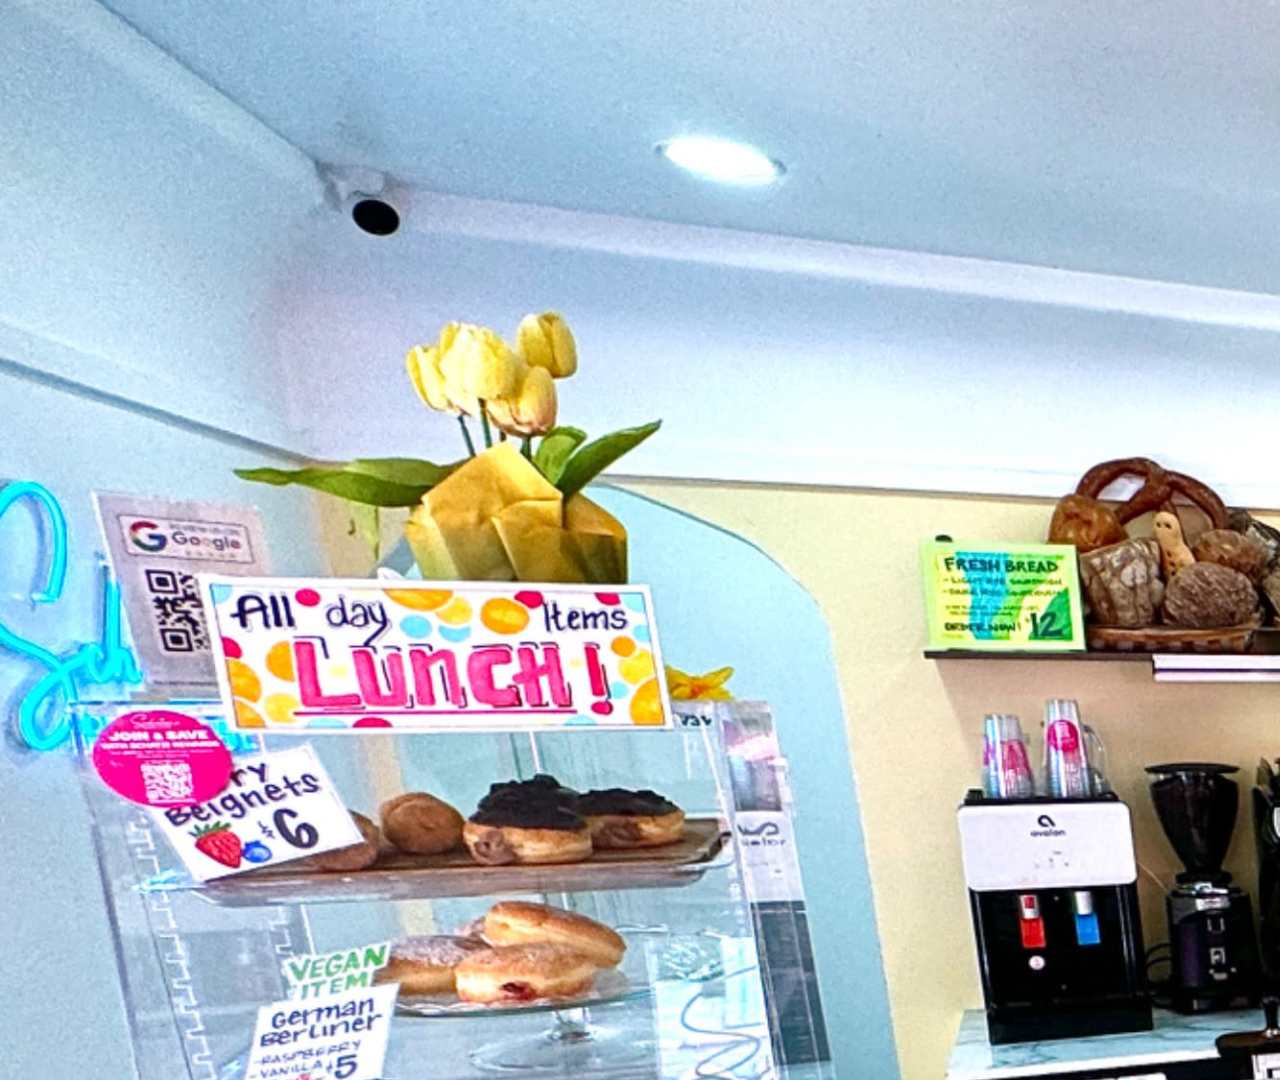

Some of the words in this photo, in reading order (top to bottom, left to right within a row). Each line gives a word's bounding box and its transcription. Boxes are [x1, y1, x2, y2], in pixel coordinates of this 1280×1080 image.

[172, 532, 241, 551] Google
[944, 558, 1000, 572] FRESH
[1005, 560, 1058, 573] BREAD
[230, 594, 295, 627] All
[326, 596, 389, 646] day
[543, 601, 628, 631] Items
[109, 731, 150, 742] JOIN
[166, 730, 208, 740] SAVE
[164, 772, 320, 826] Beignets
[288, 944, 387, 981] VEGAN
[301, 971, 368, 1000] ITEM
[272, 998, 374, 1029] German
